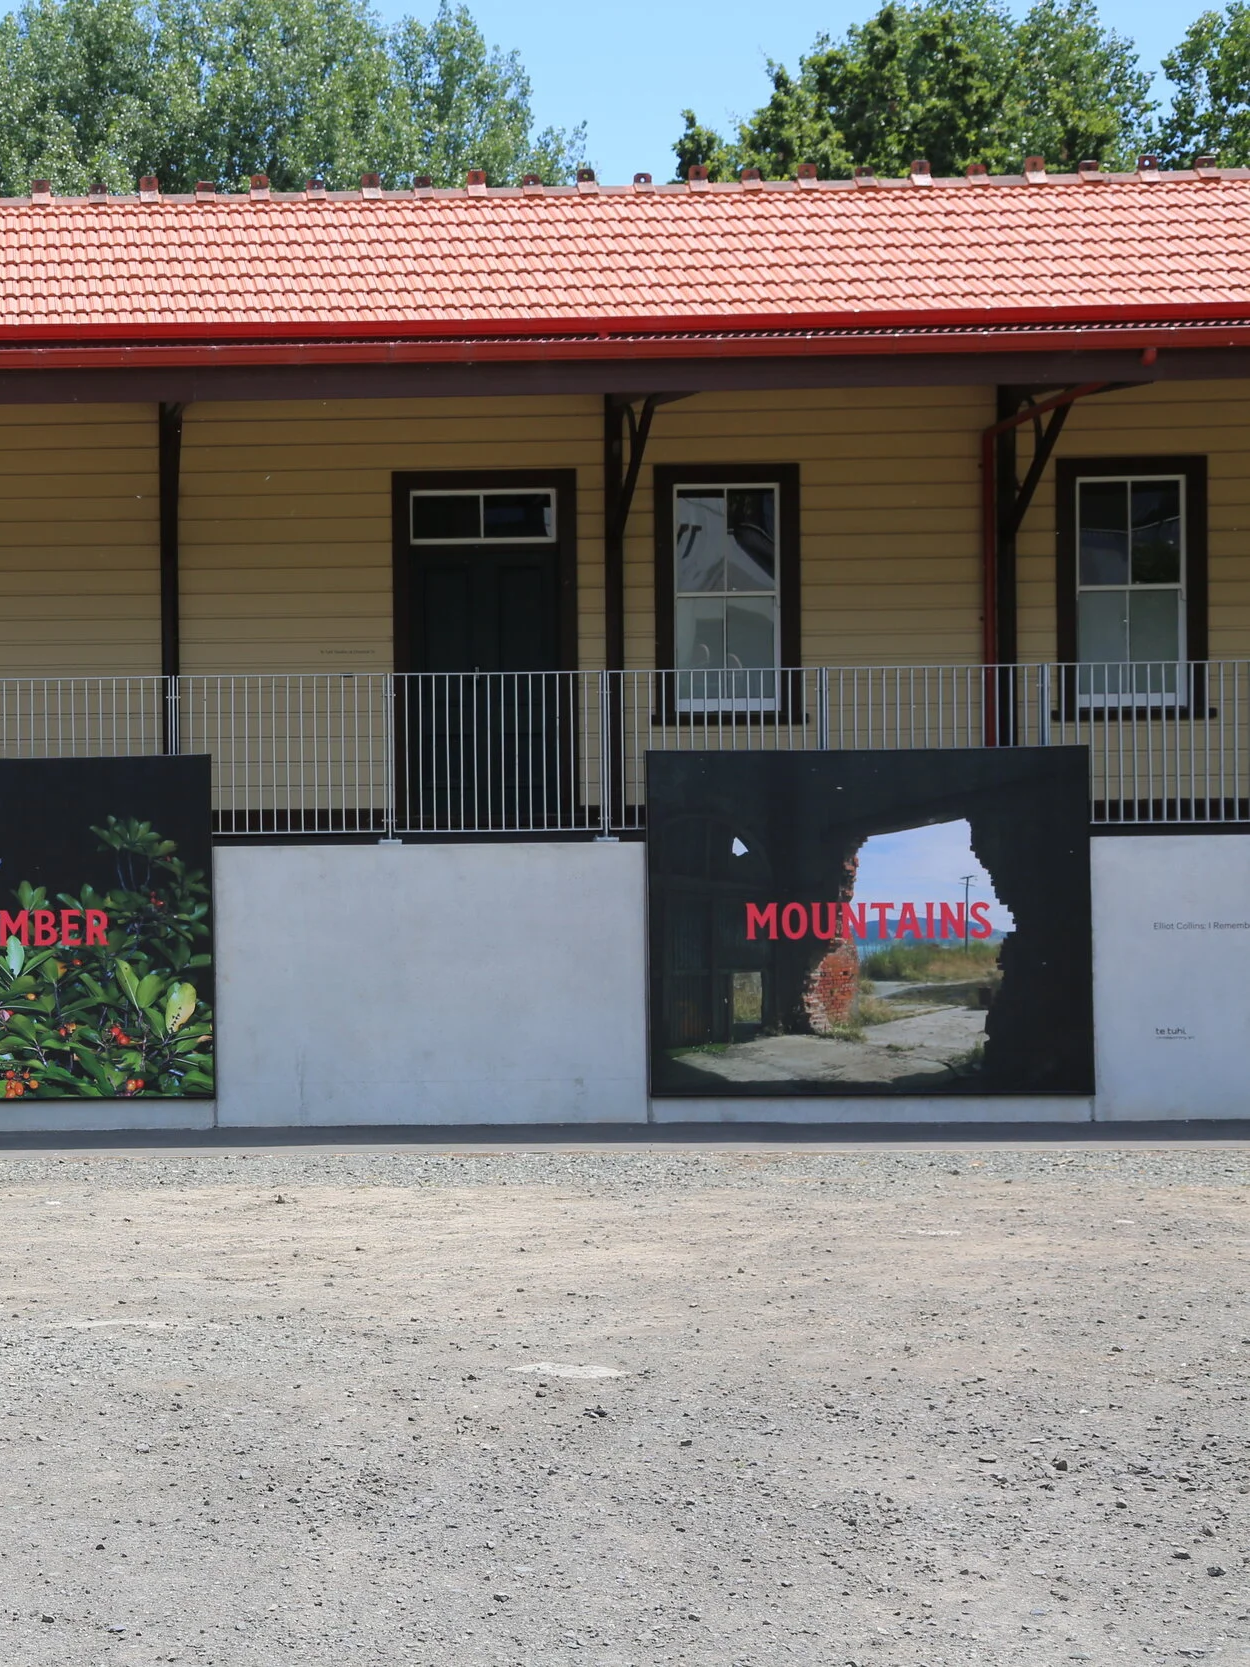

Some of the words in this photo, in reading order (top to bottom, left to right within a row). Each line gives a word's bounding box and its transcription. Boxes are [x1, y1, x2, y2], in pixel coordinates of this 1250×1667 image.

[745, 901, 993, 940] MOUNTAINS
[1153, 922, 1174, 930] Elliot
[1213, 922, 1250, 930] Rememb
[1155, 1027, 1166, 1035] te
